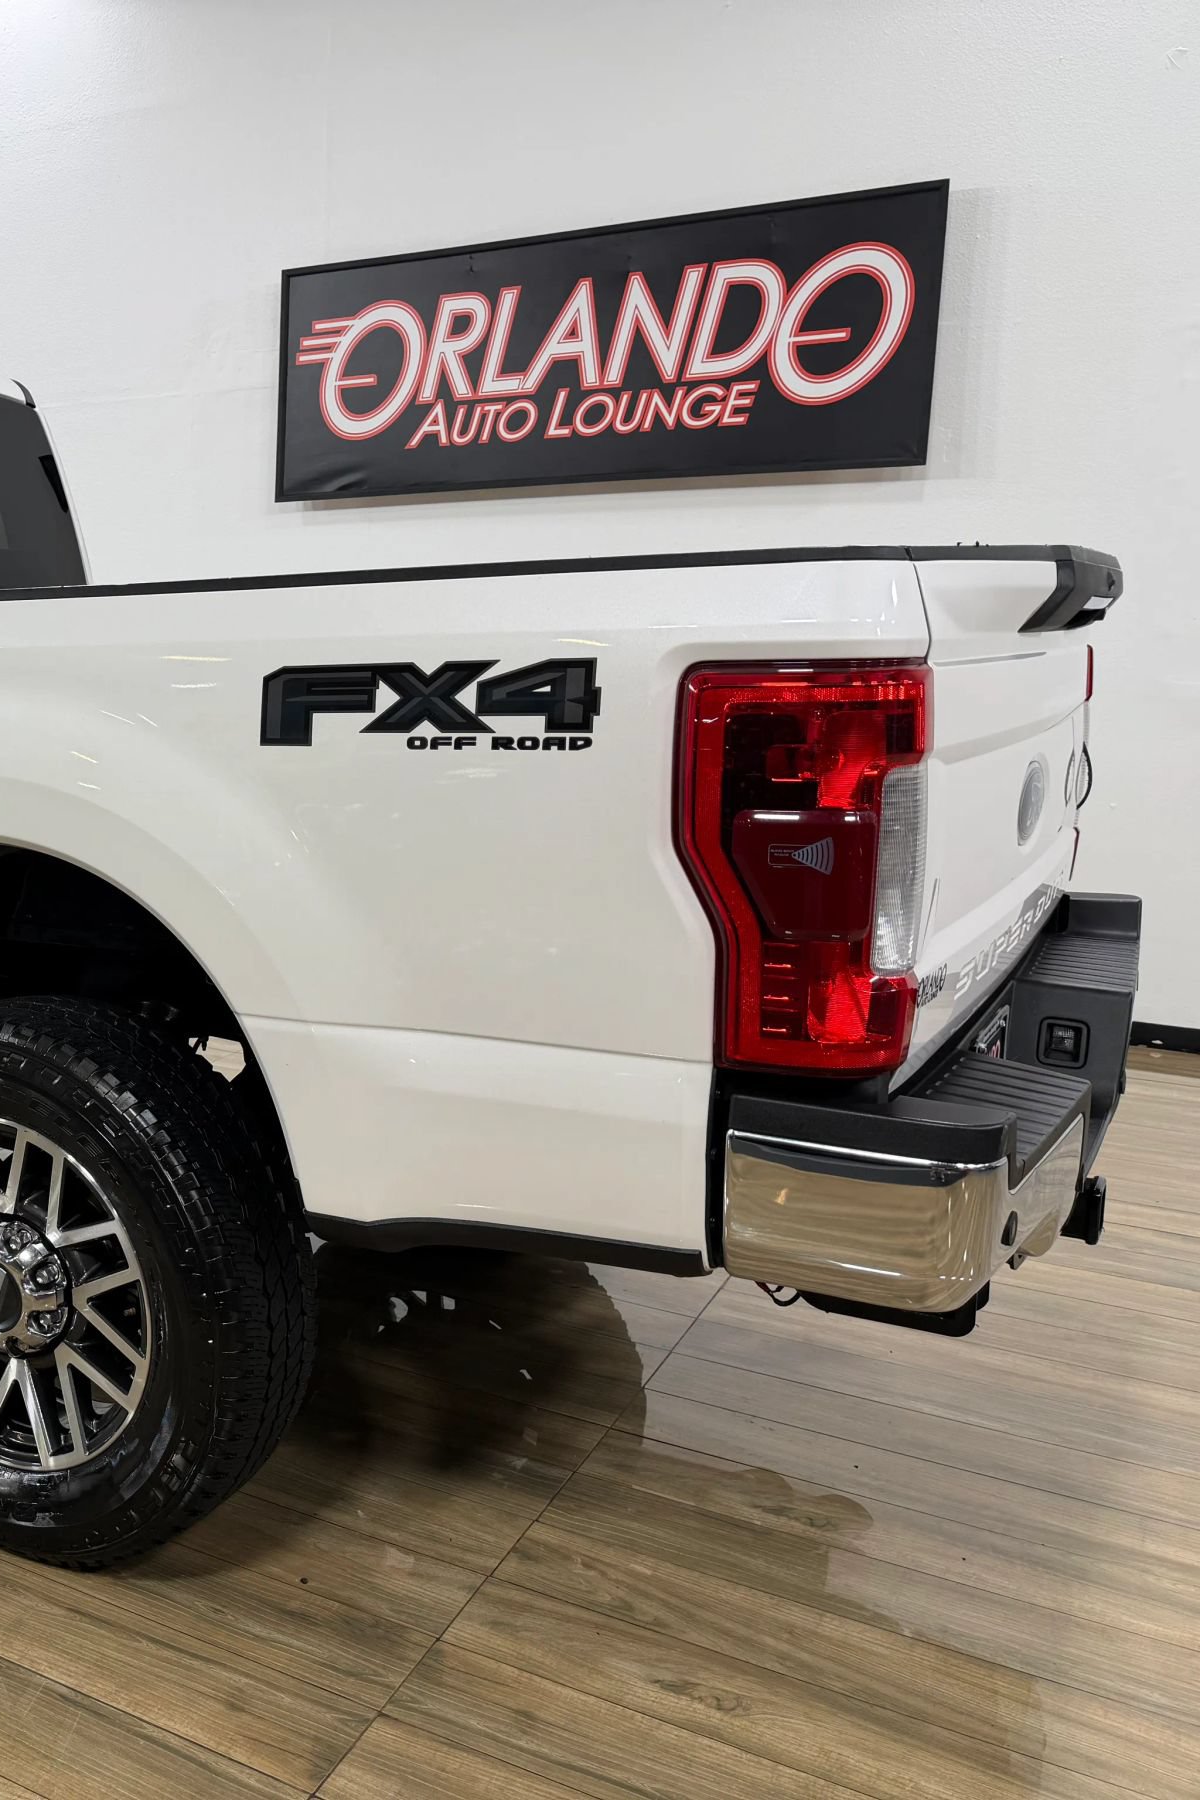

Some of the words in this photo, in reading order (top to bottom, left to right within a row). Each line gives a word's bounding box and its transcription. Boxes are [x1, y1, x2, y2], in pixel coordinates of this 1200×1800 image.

[298, 241, 915, 441] ORLANDO
[405, 399, 537, 449] AUTO
[543, 380, 760, 440] LOUNGE
[260, 657, 602, 747] FX4
[406, 736, 477, 751] OFF
[491, 736, 593, 751] ROAD
[954, 907, 1034, 1000] SUPER
